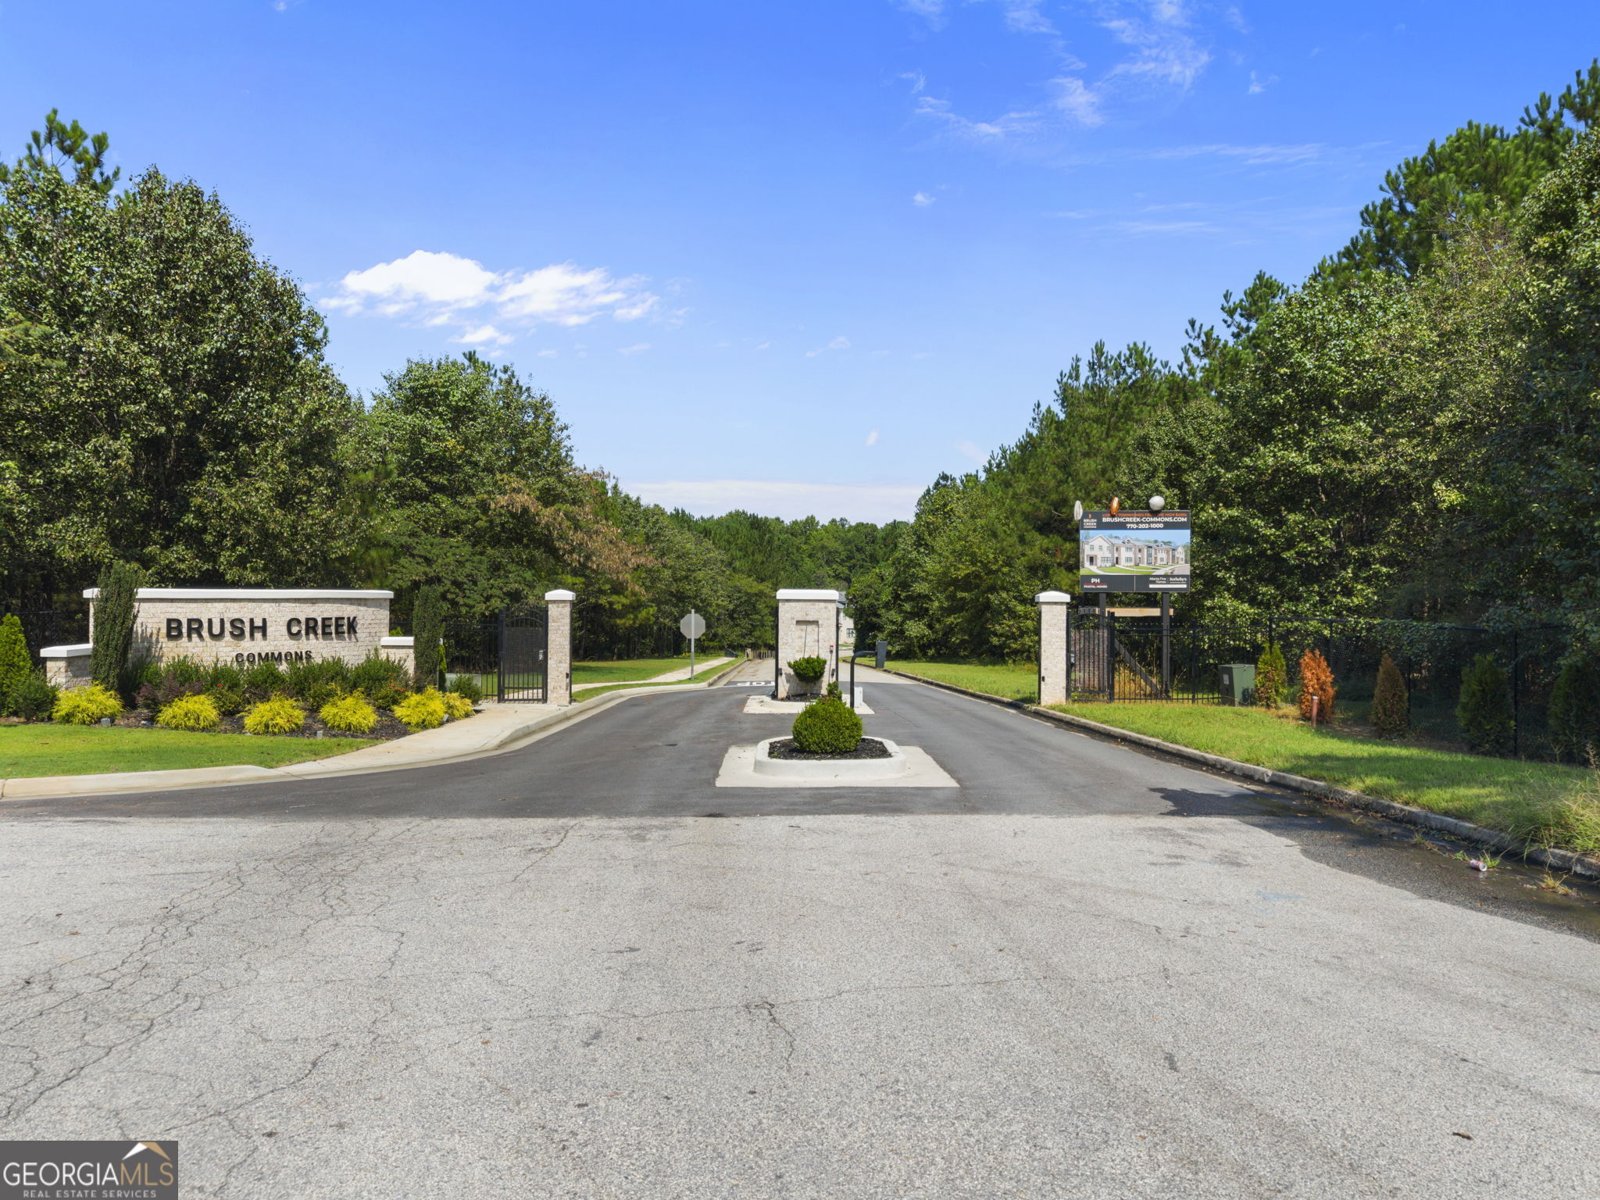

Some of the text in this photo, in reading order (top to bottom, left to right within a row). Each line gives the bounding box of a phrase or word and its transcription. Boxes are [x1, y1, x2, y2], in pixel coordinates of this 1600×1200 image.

[165, 616, 358, 639] BRUSH CREEK
[235, 650, 313, 664] COMMONS
